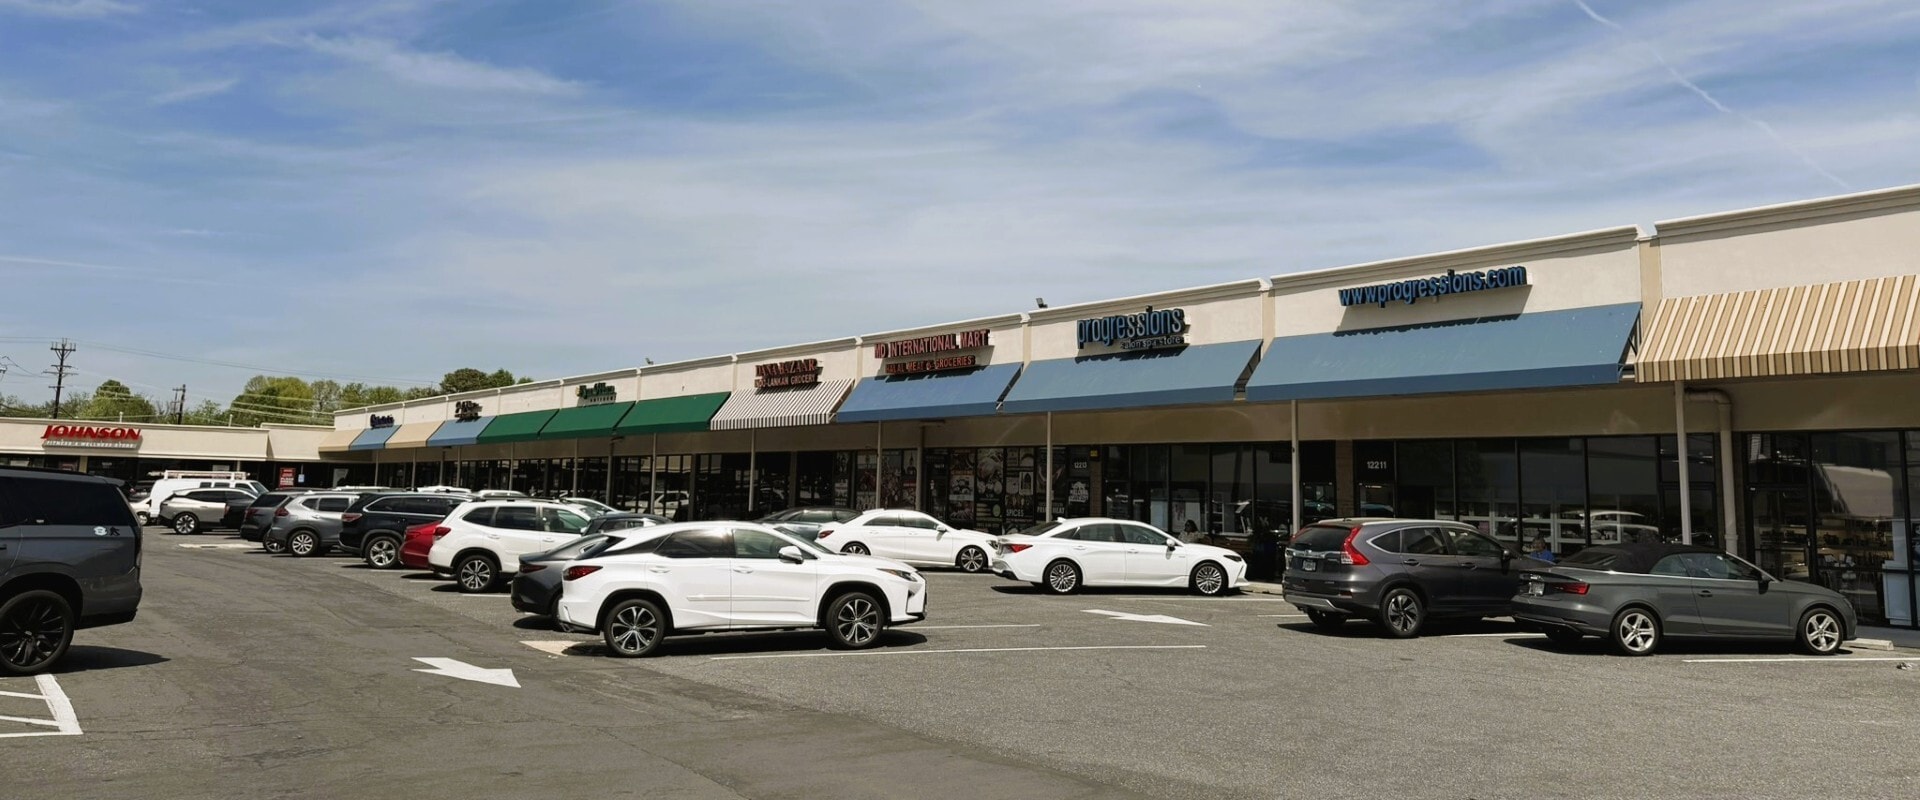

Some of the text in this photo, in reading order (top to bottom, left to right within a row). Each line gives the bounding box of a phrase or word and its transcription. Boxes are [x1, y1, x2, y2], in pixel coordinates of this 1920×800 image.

[1077, 306, 1184, 349] progressions
[874, 329, 989, 358] MD INTERNATIONAL MART
[1121, 336, 1181, 350] salon spa store
[779, 359, 817, 375] BAZAAR
[934, 355, 975, 370] GROCERIES
[790, 373, 817, 385] GROCERY
[41, 425, 141, 440] JOHNSON
[1367, 460, 1387, 469] 12211
